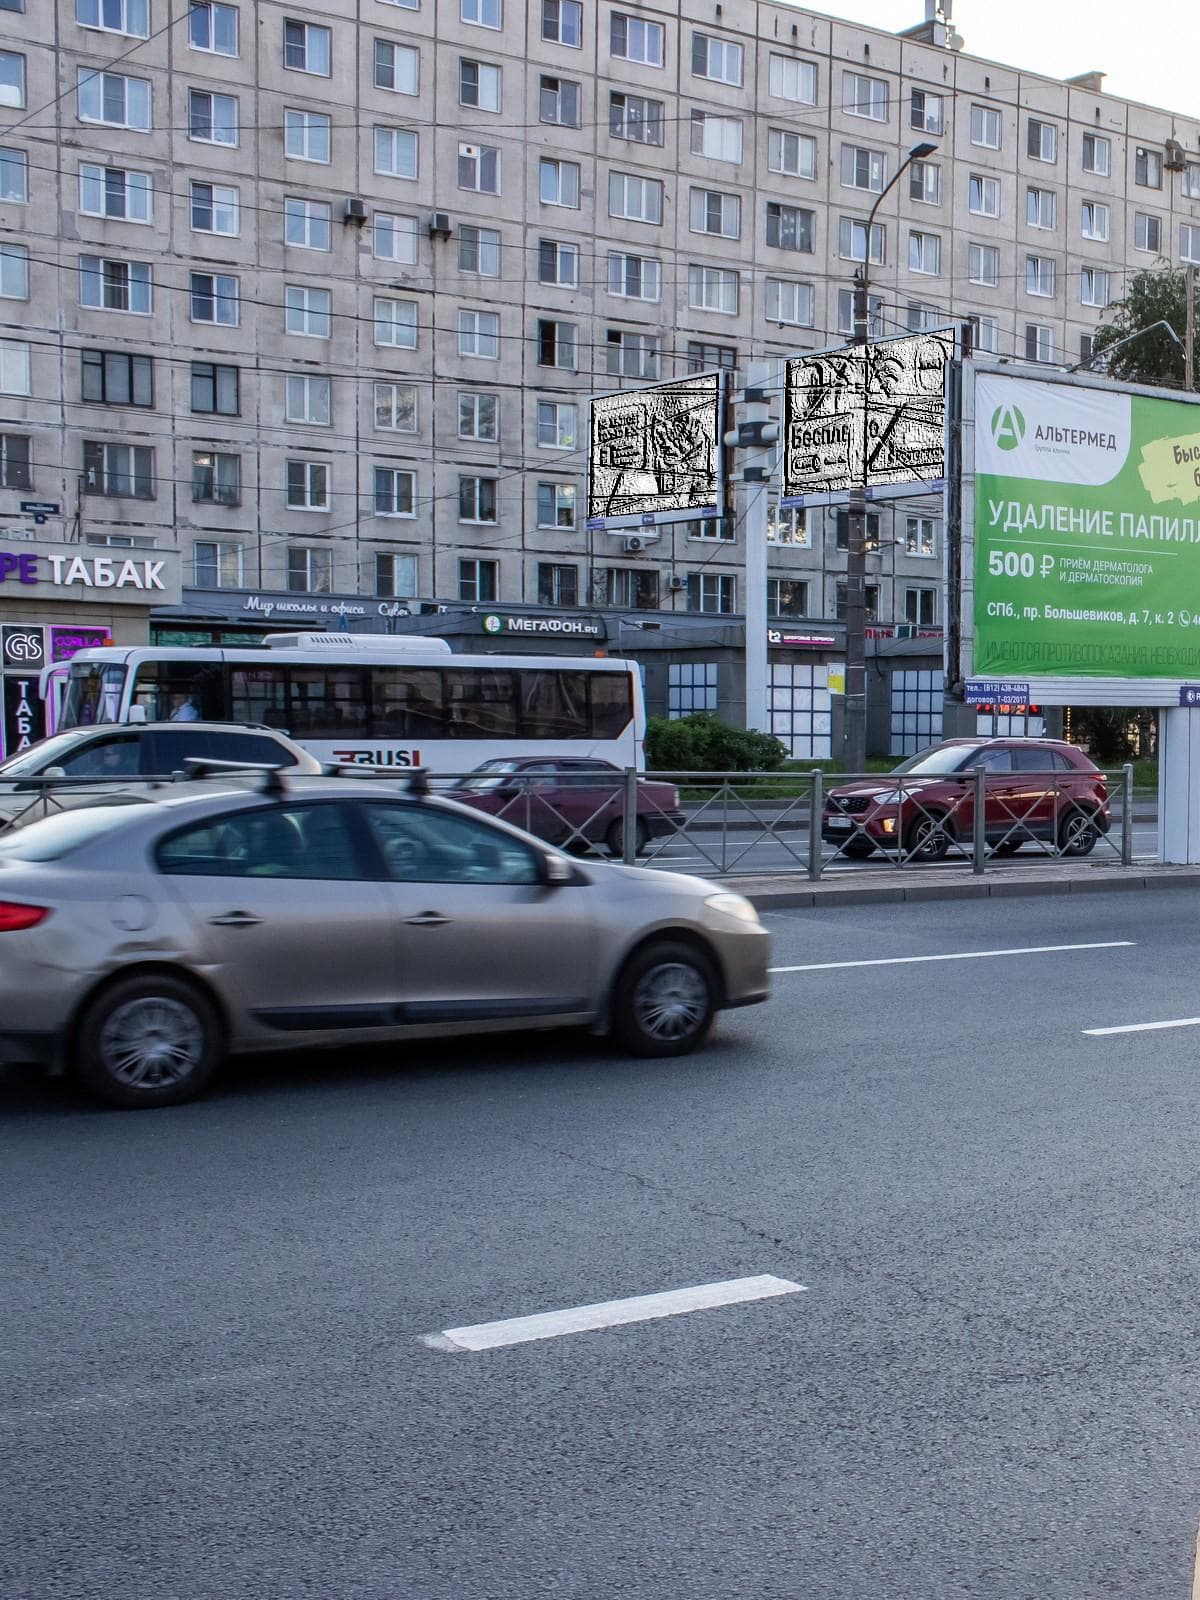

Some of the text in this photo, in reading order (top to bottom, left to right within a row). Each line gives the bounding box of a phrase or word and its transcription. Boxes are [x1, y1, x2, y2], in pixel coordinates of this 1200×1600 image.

[1034, 424, 1117, 451] АЛЬТЕРМЕД
[988, 500, 1114, 536] УДАЛЕНИЕ
[48, 555, 166, 590] ТАБАК
[988, 550, 1035, 578] 500
[1093, 560, 1153, 574] ДЕРМАТОЛОГА
[1060, 571, 1143, 586] И ДЕРМАТОСКОПИЯ
[243, 596, 365, 616] Мир школы и офиса
[987, 602, 1020, 620] СПб.,
[1023, 606, 1041, 621] пр.
[1044, 605, 1127, 625] Большевиков,
[1128, 611, 1140, 625] д.
[1142, 610, 1152, 626] 7,
[1155, 613, 1164, 624] к.
[1167, 611, 1175, 624] 2
[5, 633, 42, 660] GS
